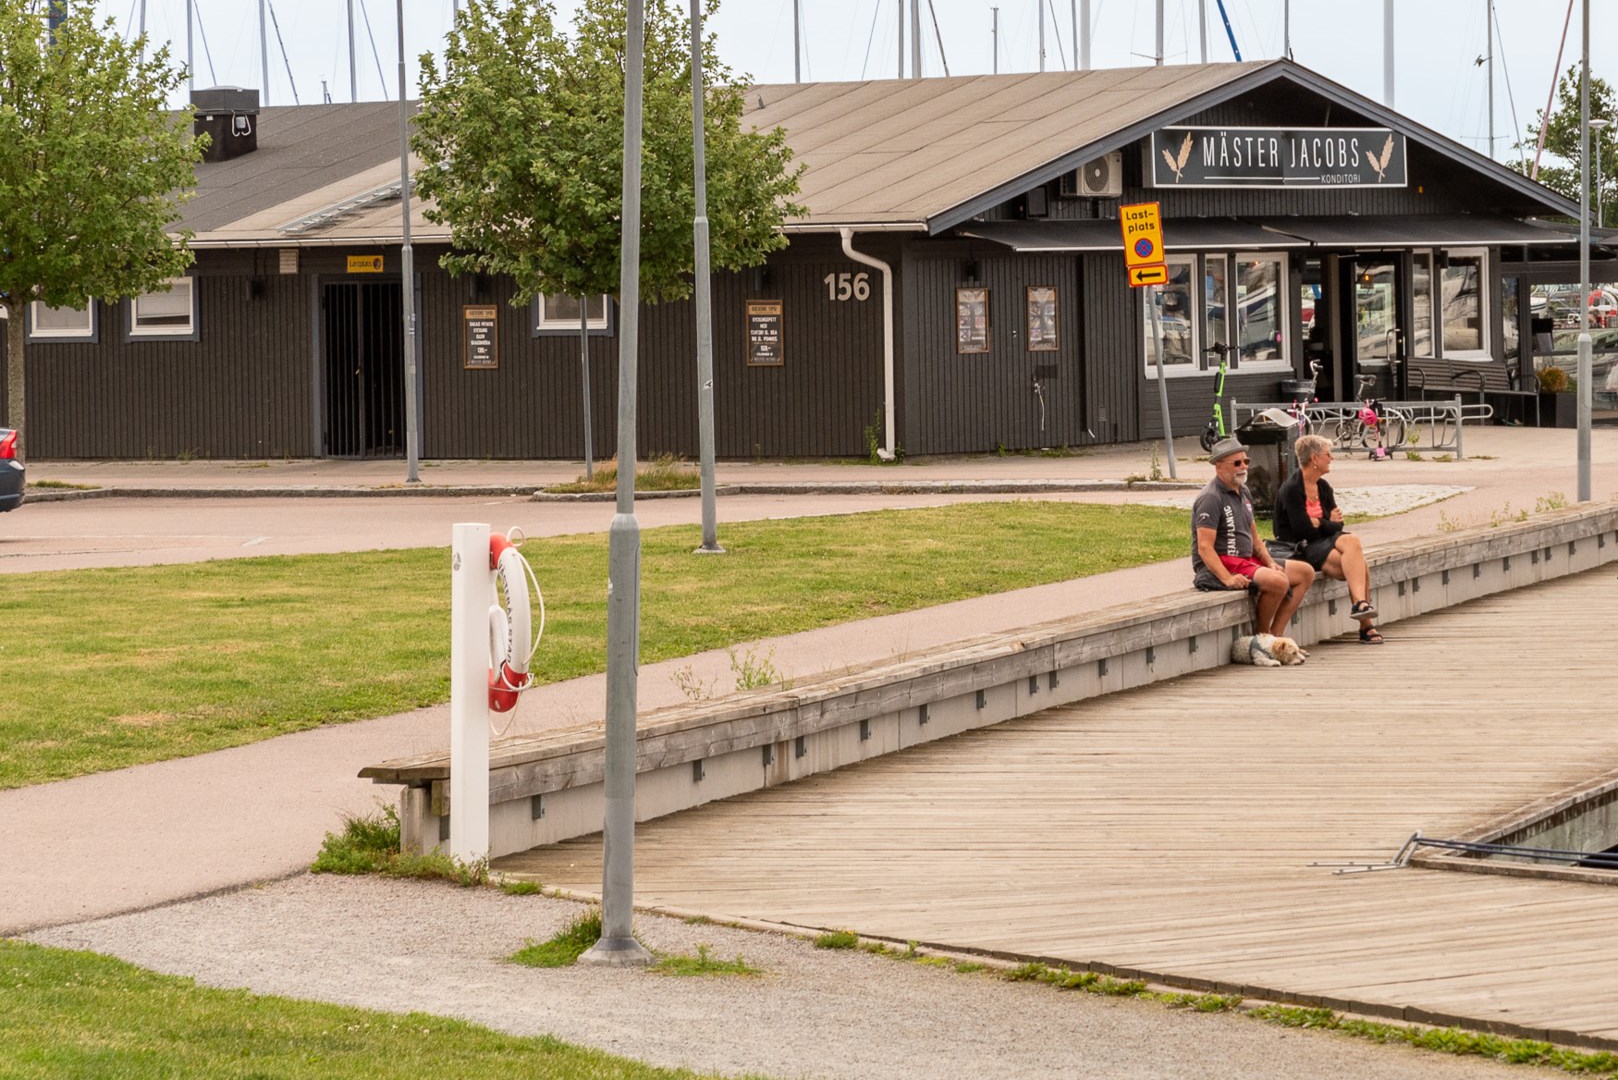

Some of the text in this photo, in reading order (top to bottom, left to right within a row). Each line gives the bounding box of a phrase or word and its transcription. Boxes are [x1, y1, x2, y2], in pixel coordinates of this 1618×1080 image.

[1203, 131, 1360, 168] MÄSTER JACOBS
[1321, 174, 1361, 184] KONDITORI
[1126, 209, 1154, 221] Last-
[1128, 222, 1155, 234] plats
[823, 272, 870, 301] 156
